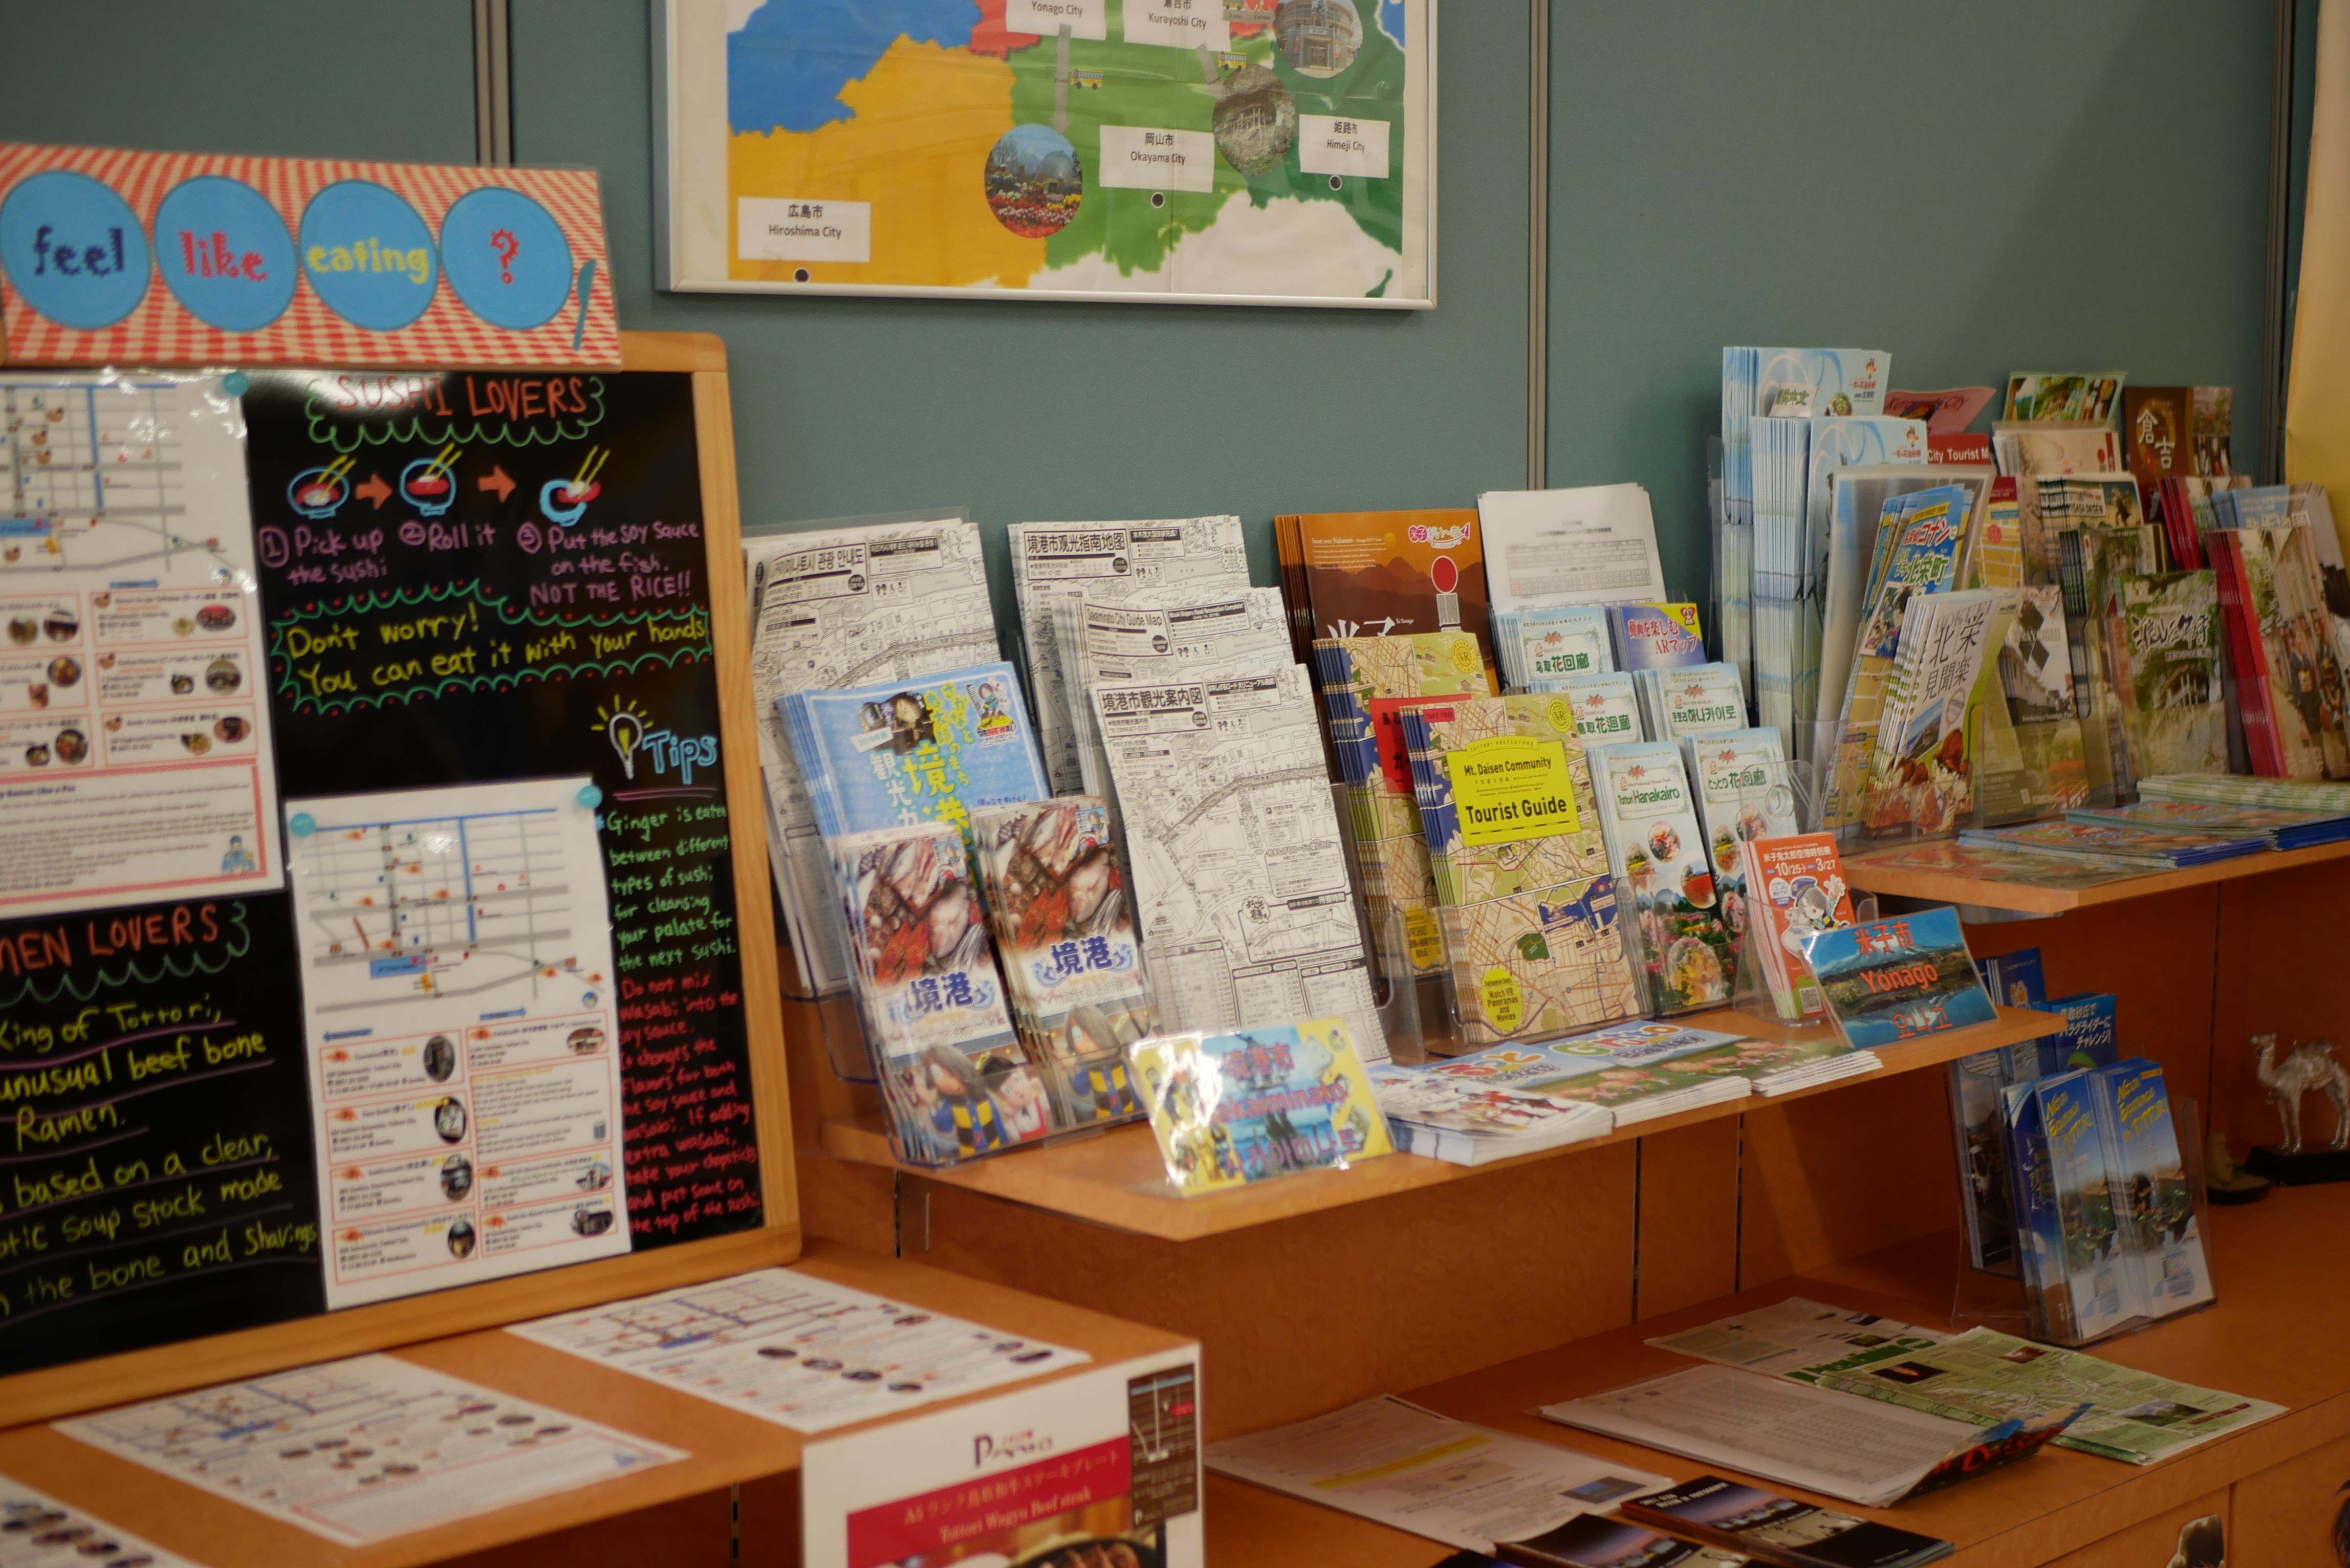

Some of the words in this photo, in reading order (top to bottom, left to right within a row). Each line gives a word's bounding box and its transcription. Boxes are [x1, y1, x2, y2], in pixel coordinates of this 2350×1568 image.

[1032, 1, 1063, 15] Yonago
[1067, 5, 1082, 17] City
[1149, 13, 1189, 27] Kurayoshi
[1191, 17, 1207, 30] City
[1145, 133, 1174, 147] 岡山市
[1334, 121, 1358, 135] 姫路市
[1130, 151, 1170, 164] Okayama
[1171, 153, 1186, 166] City
[1326, 139, 1351, 151] Himeji
[1353, 141, 1365, 153] City
[788, 204, 823, 219] 広島市
[769, 225, 819, 237] Hiroshima
[823, 226, 841, 240] City
[33, 225, 125, 276] feel
[179, 230, 268, 282] like
[307, 237, 429, 284] eating
[490, 228, 520, 285] ?
[336, 376, 454, 417] SUSHI
[466, 376, 588, 421] LOVERS
[2137, 408, 2175, 469] 倉吉
[1928, 449, 1944, 463] City
[1947, 447, 1978, 461] Tourist
[294, 529, 346, 555] Pick
[352, 529, 384, 551] up
[428, 523, 469, 552] Roll
[476, 522, 496, 547] it
[548, 529, 587, 552] Put
[590, 524, 617, 547] the
[1028, 533, 1125, 553] 境港市观光指南地图
[551, 556, 576, 575] on
[578, 550, 611, 574] the
[837, 549, 863, 568] 안내도
[1903, 552, 1950, 585] 北栄町
[287, 563, 327, 584] the
[530, 581, 576, 606] NOT
[586, 580, 620, 603] THE
[630, 572, 691, 597] RICE!!
[287, 624, 358, 660] Don't
[381, 602, 481, 644] worry!
[1126, 614, 1145, 626] Guide
[1146, 614, 1163, 627] Map
[1628, 618, 1679, 639] 動画を楽しむ
[1656, 634, 1699, 654] ARマップ
[1929, 613, 1984, 667] 北栄
[299, 662, 353, 698] You
[372, 657, 423, 686] can
[431, 649, 477, 677] eat
[490, 640, 513, 667] it
[526, 633, 577, 665] with
[589, 631, 638, 661] your
[1102, 687, 1203, 711] 境港市観光案内図
[642, 729, 717, 785] Tips
[1464, 765, 1476, 777] Mt.
[1477, 763, 1504, 775] Daisen
[1505, 756, 1551, 772] Community
[1708, 768, 1766, 790] とっとり花回廊
[1633, 786, 1680, 804] Hanakairo
[606, 811, 668, 842] Ginger
[676, 806, 692, 822] is
[695, 804, 728, 820] eaten
[1465, 802, 1519, 824] Tourist
[1521, 796, 1567, 817] Guide
[608, 848, 672, 867] between
[676, 835, 729, 857] different
[611, 876, 654, 897] types
[660, 867, 673, 887] of
[678, 864, 714, 886] sushi
[614, 904, 639, 921] for
[647, 896, 710, 916] cleansing
[88, 903, 219, 956] LOVERS
[617, 928, 648, 950] your
[654, 917, 708, 943] palate
[710, 911, 733, 930] for
[1854, 920, 1914, 956] 米子市
[618, 954, 643, 972] the
[648, 950, 684, 969] next
[1051, 935, 1113, 974] 境港
[621, 977, 644, 1000] Do
[648, 977, 676, 994] not
[910, 972, 975, 1012] 境港
[1860, 964, 1939, 994] Yonago
[1488, 990, 1505, 998] Watch
[1488, 997, 1518, 1008] Panoramas
[1496, 1013, 1516, 1022] Movies
[1499, 1005, 1509, 1013] and
[1892, 1006, 1953, 1039] 요나고
[62, 1008, 100, 1042] of
[129, 1036, 192, 1080] beef
[205, 1032, 266, 1064] bone
[14, 1156, 103, 1208] based
[114, 1160, 149, 1186] on
[164, 1153, 187, 1175] a
[221, 1168, 283, 1202] made
[25, 1278, 74, 1304] the
[89, 1256, 165, 1290] bone
[183, 1228, 233, 1268] and
[1031, 1495, 1058, 1517] Beef
[1060, 1485, 1092, 1507] steak
